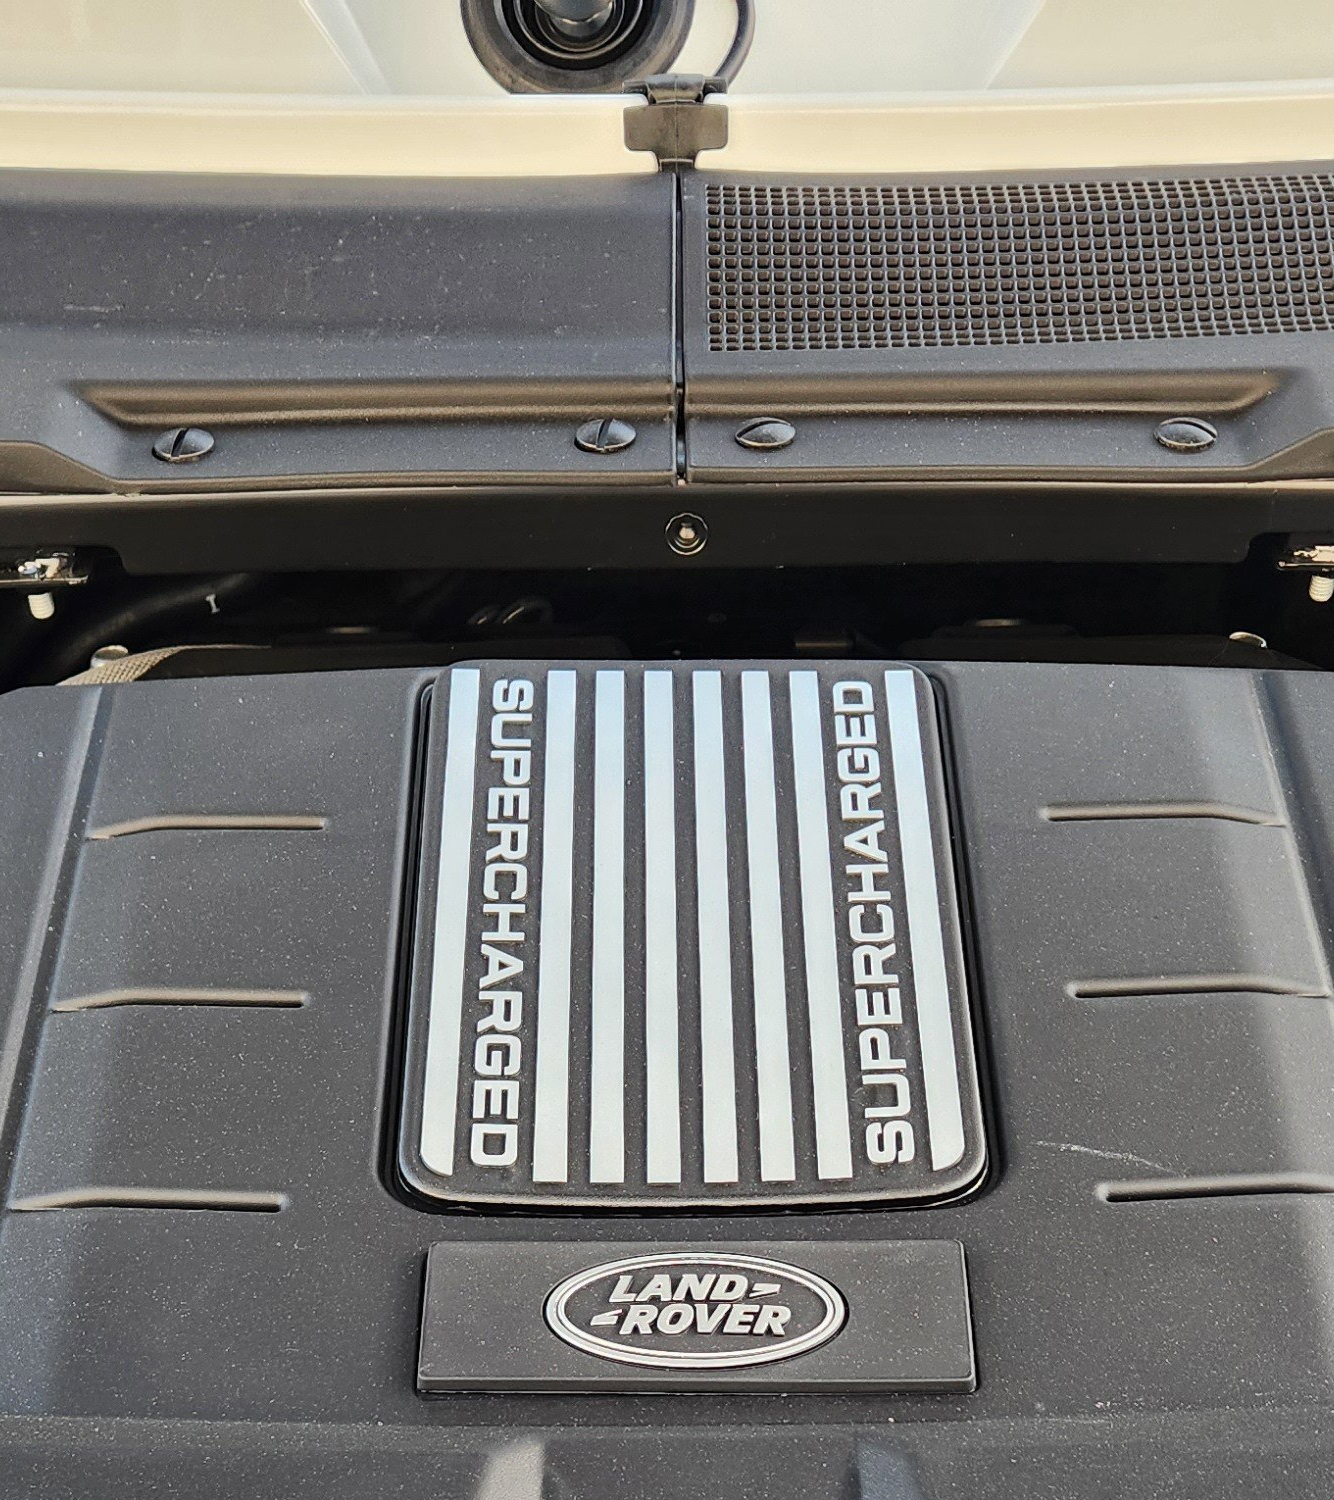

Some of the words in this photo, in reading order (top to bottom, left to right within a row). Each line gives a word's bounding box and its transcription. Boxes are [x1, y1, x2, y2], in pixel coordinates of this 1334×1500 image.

[469, 678, 535, 1168] SUPERCHARGED
[831, 679, 916, 1165] SUPERCHARGED
[609, 1273, 749, 1303] LAND
[618, 1303, 793, 1337] ROVER
